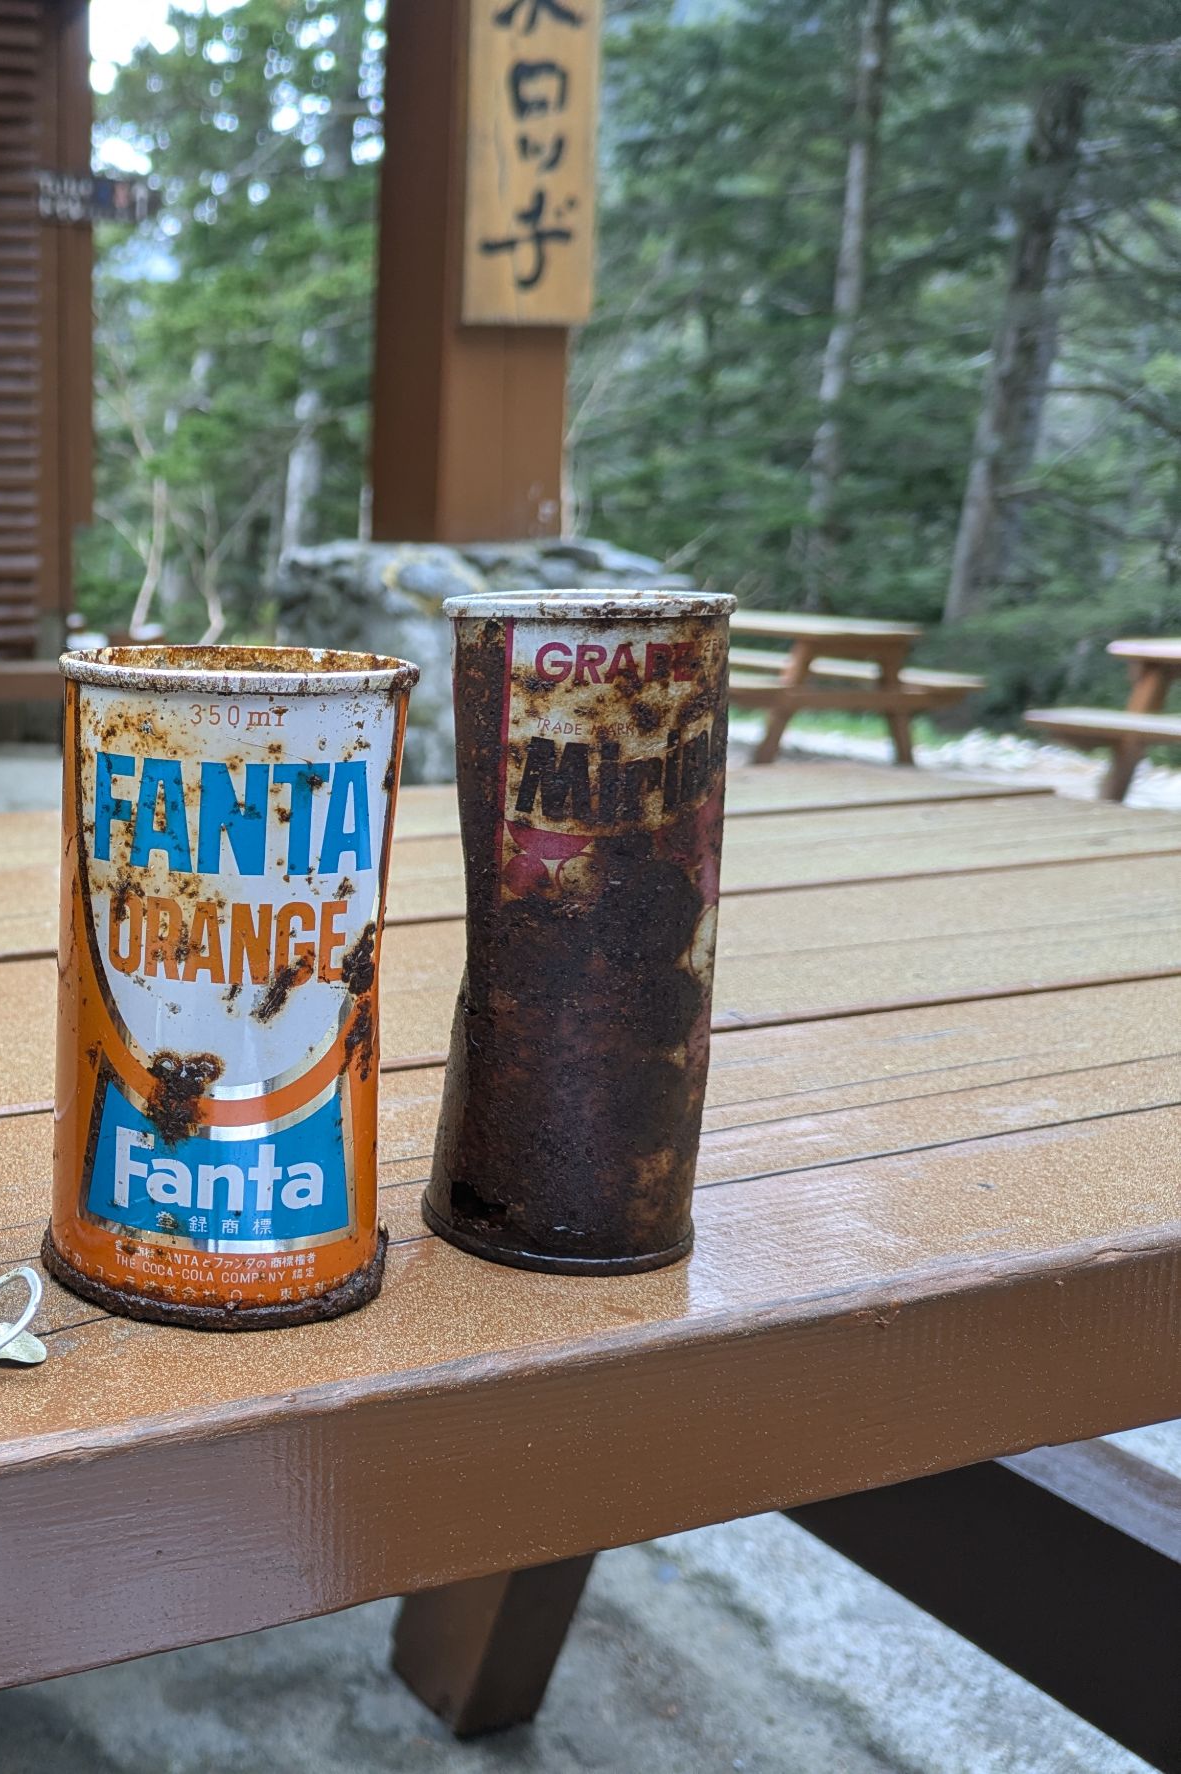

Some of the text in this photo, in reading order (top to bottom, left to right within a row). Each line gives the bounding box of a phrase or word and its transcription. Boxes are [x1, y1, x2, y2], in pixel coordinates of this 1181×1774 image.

[534, 641, 696, 685] GRAPE
[536, 717, 636, 738] TRADE MARK
[94, 751, 372, 877] FANTA
[108, 890, 350, 988] ORANGE
[113, 1126, 325, 1212] Fanta
[155, 1210, 273, 1236] 登録商標
[116, 1253, 136, 1269] THE
[142, 1260, 215, 1283] COCA-COLA
